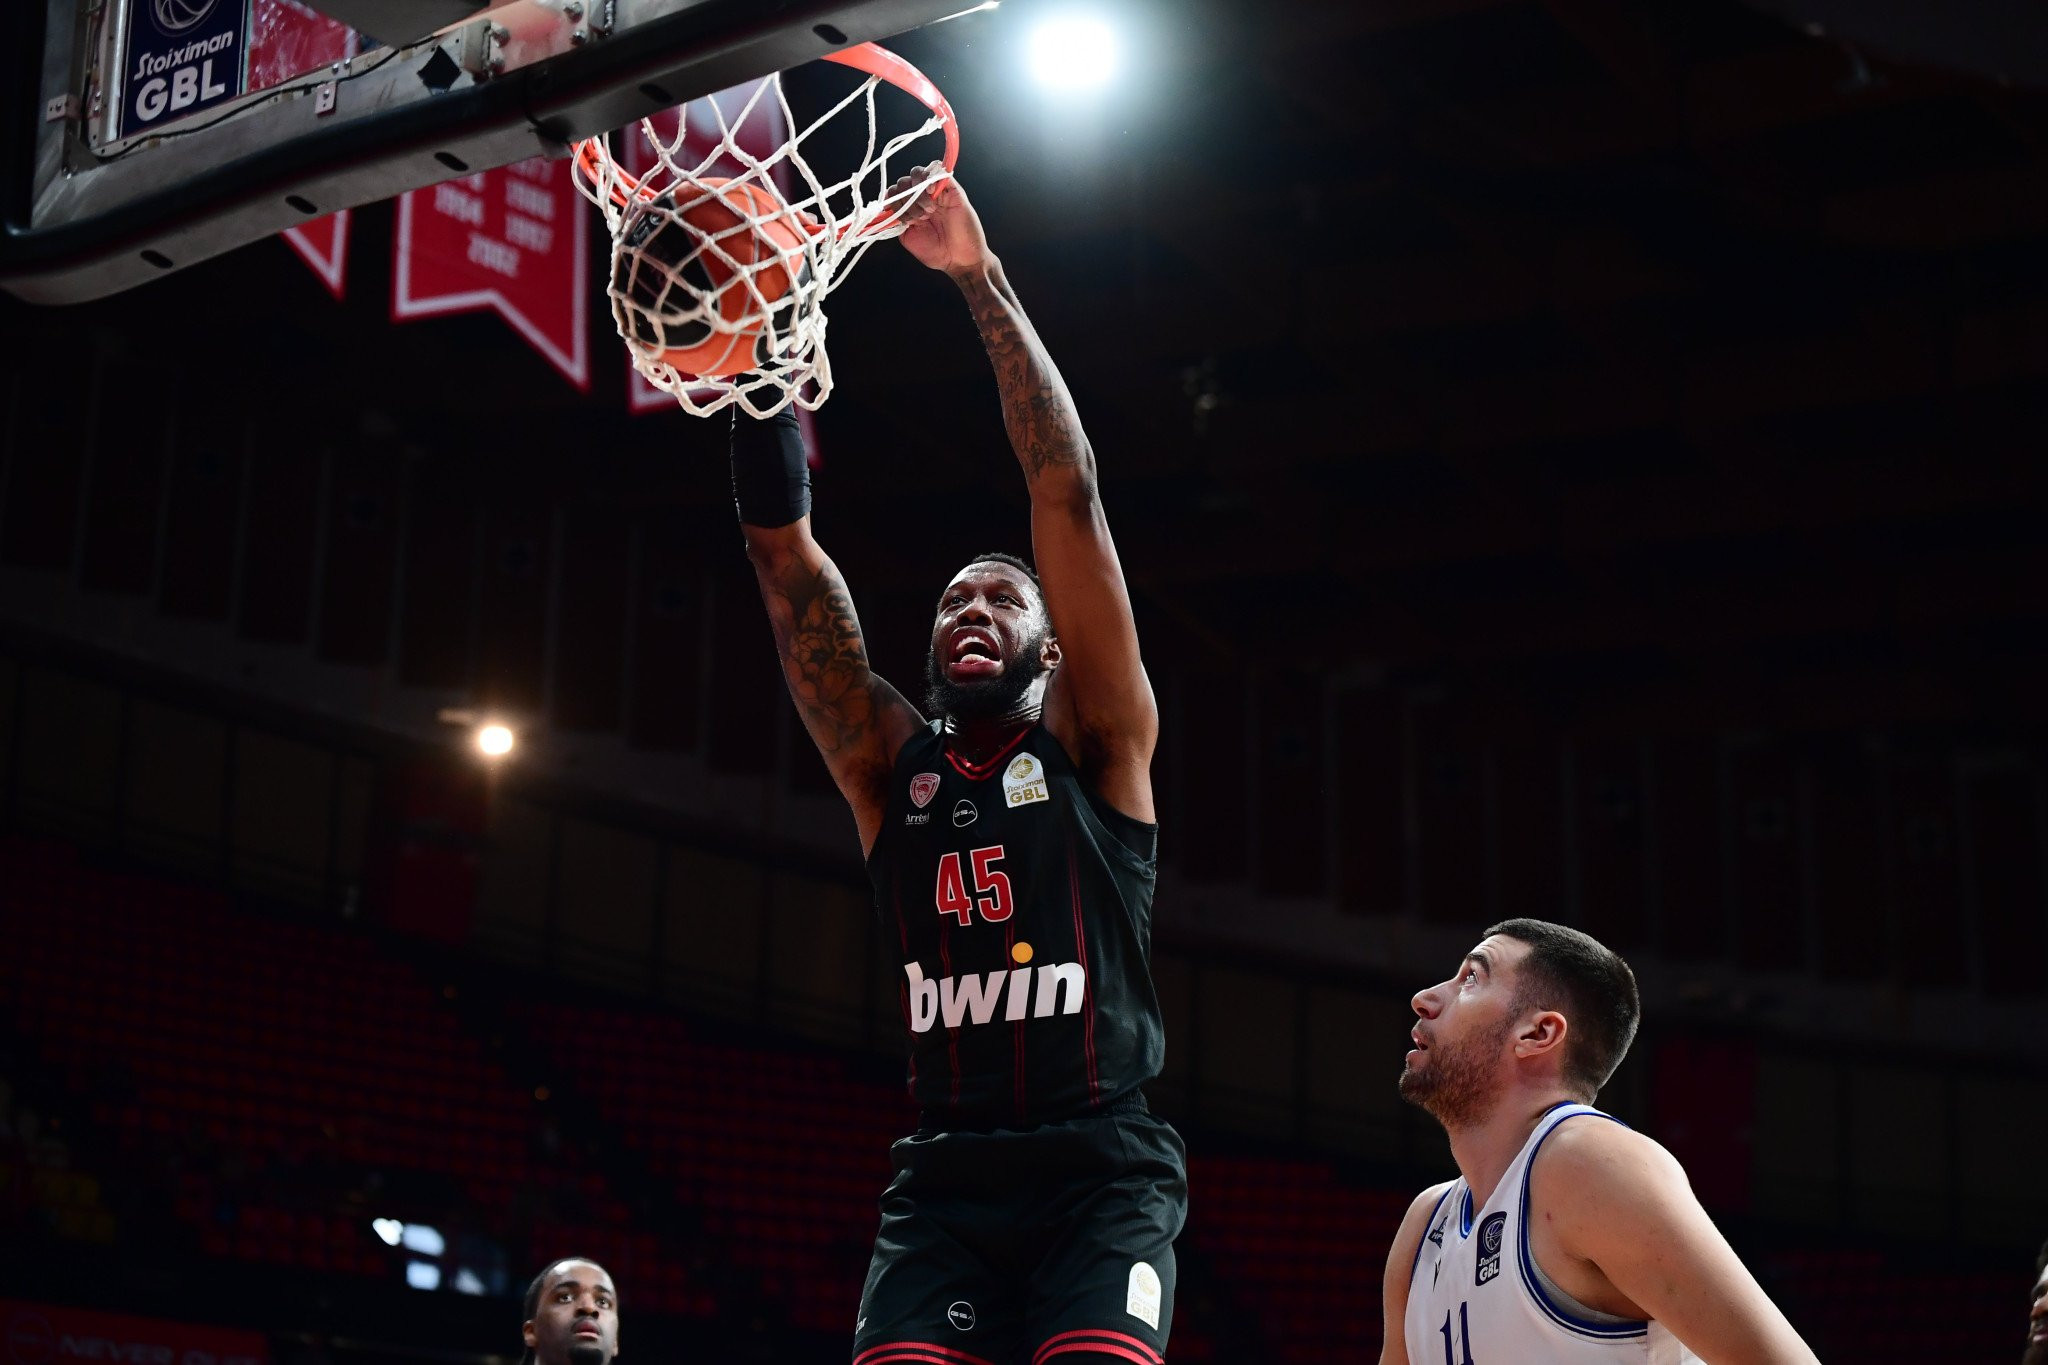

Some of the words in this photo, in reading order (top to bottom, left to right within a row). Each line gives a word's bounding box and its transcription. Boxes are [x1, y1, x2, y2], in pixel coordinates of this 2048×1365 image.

[133, 30, 234, 81] Stoiximan
[135, 58, 226, 121] GBL
[1010, 786, 1046, 804] GBL
[936, 845, 1014, 926] 45
[904, 941, 1086, 1033] bwin
[1479, 1259, 1499, 1282] GBL
[1130, 1301, 1157, 1327] GBL
